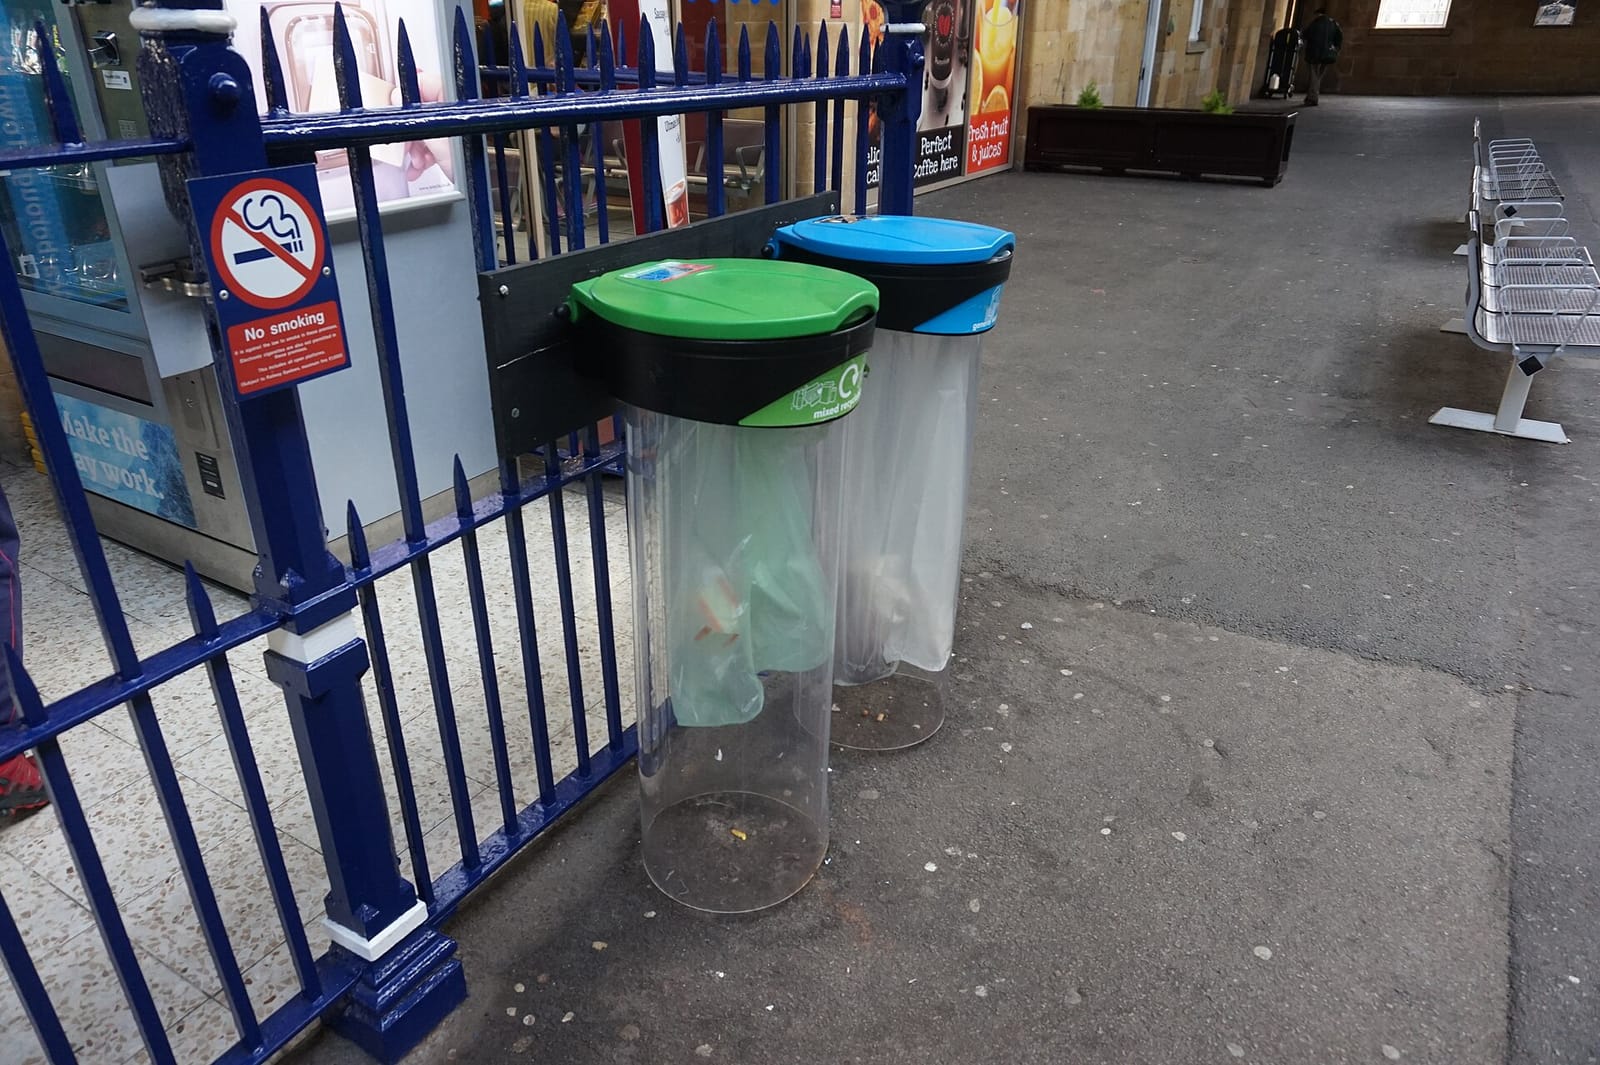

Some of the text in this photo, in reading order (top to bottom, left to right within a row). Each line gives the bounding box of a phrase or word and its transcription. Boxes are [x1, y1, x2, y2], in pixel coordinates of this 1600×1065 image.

[990, 116, 1009, 138] fruit
[920, 130, 953, 156] Perfect
[972, 141, 1002, 166] & juices
[940, 154, 958, 173] here
[244, 311, 325, 342] No smoking
[813, 403, 840, 419] mixed
[61, 410, 150, 461] Make the
[72, 452, 98, 482] ay
[99, 460, 165, 500] work.
